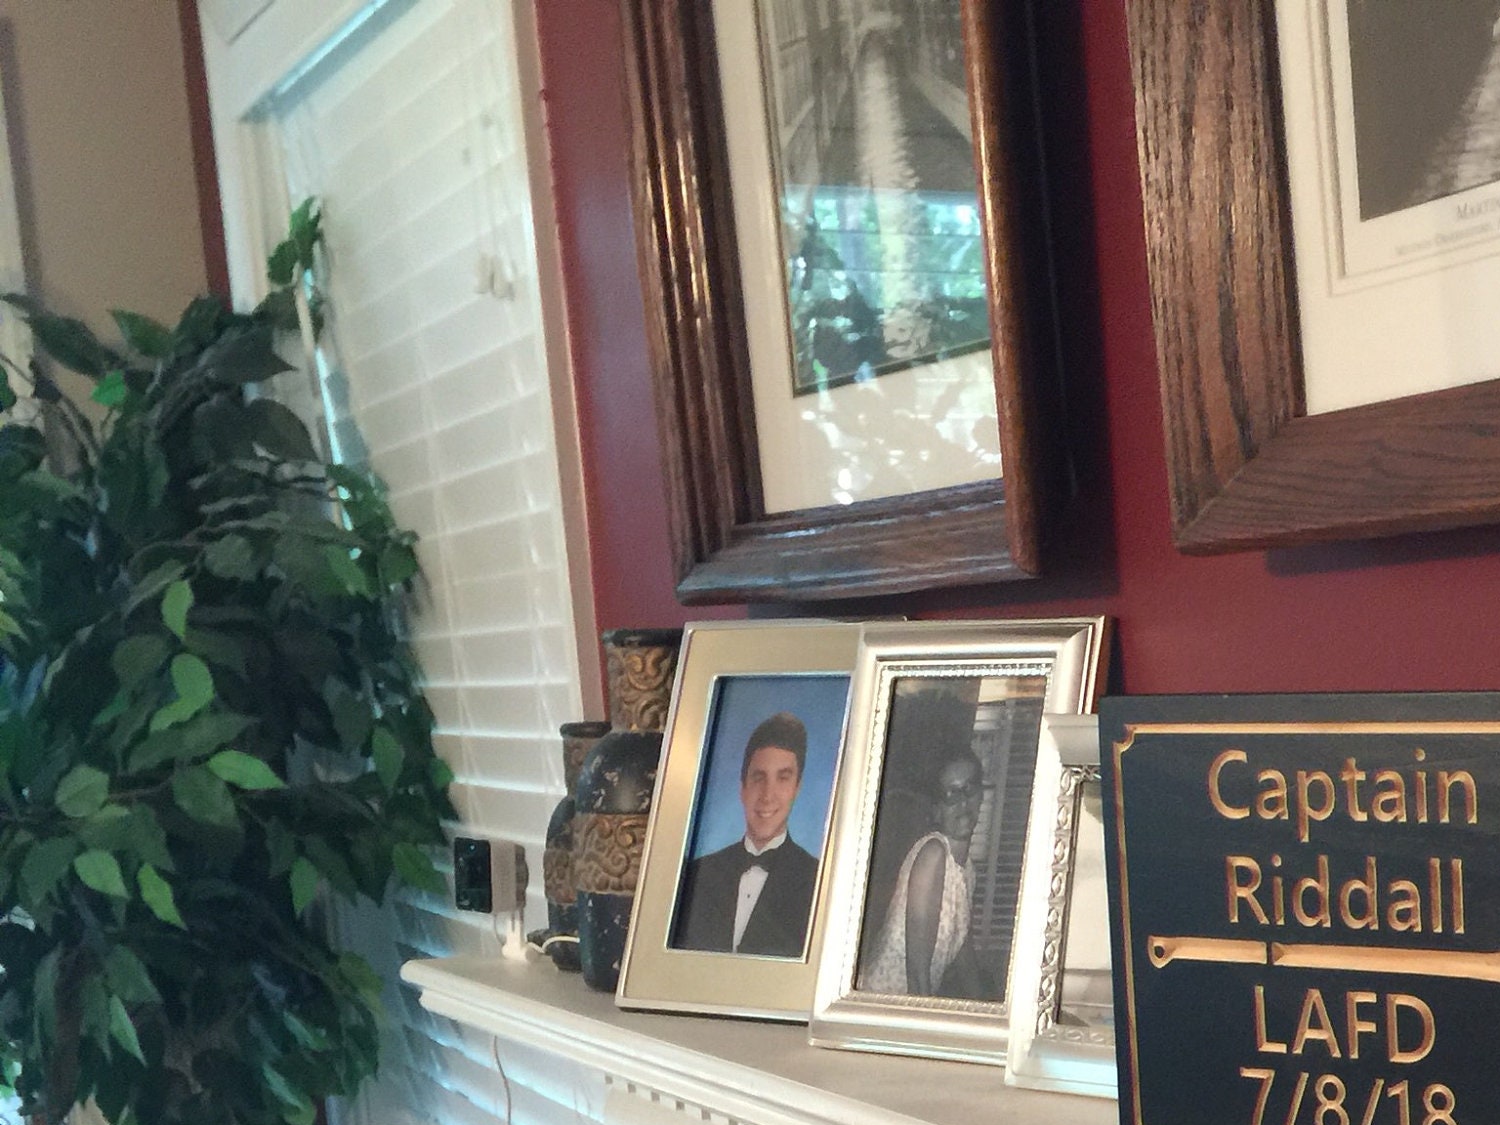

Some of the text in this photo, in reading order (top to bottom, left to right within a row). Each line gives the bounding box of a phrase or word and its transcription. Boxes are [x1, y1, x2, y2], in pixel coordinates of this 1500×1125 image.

[1207, 748, 1478, 843] Captain
[1225, 854, 1465, 935] Riddall
[1254, 985, 1436, 1064] LAFD
